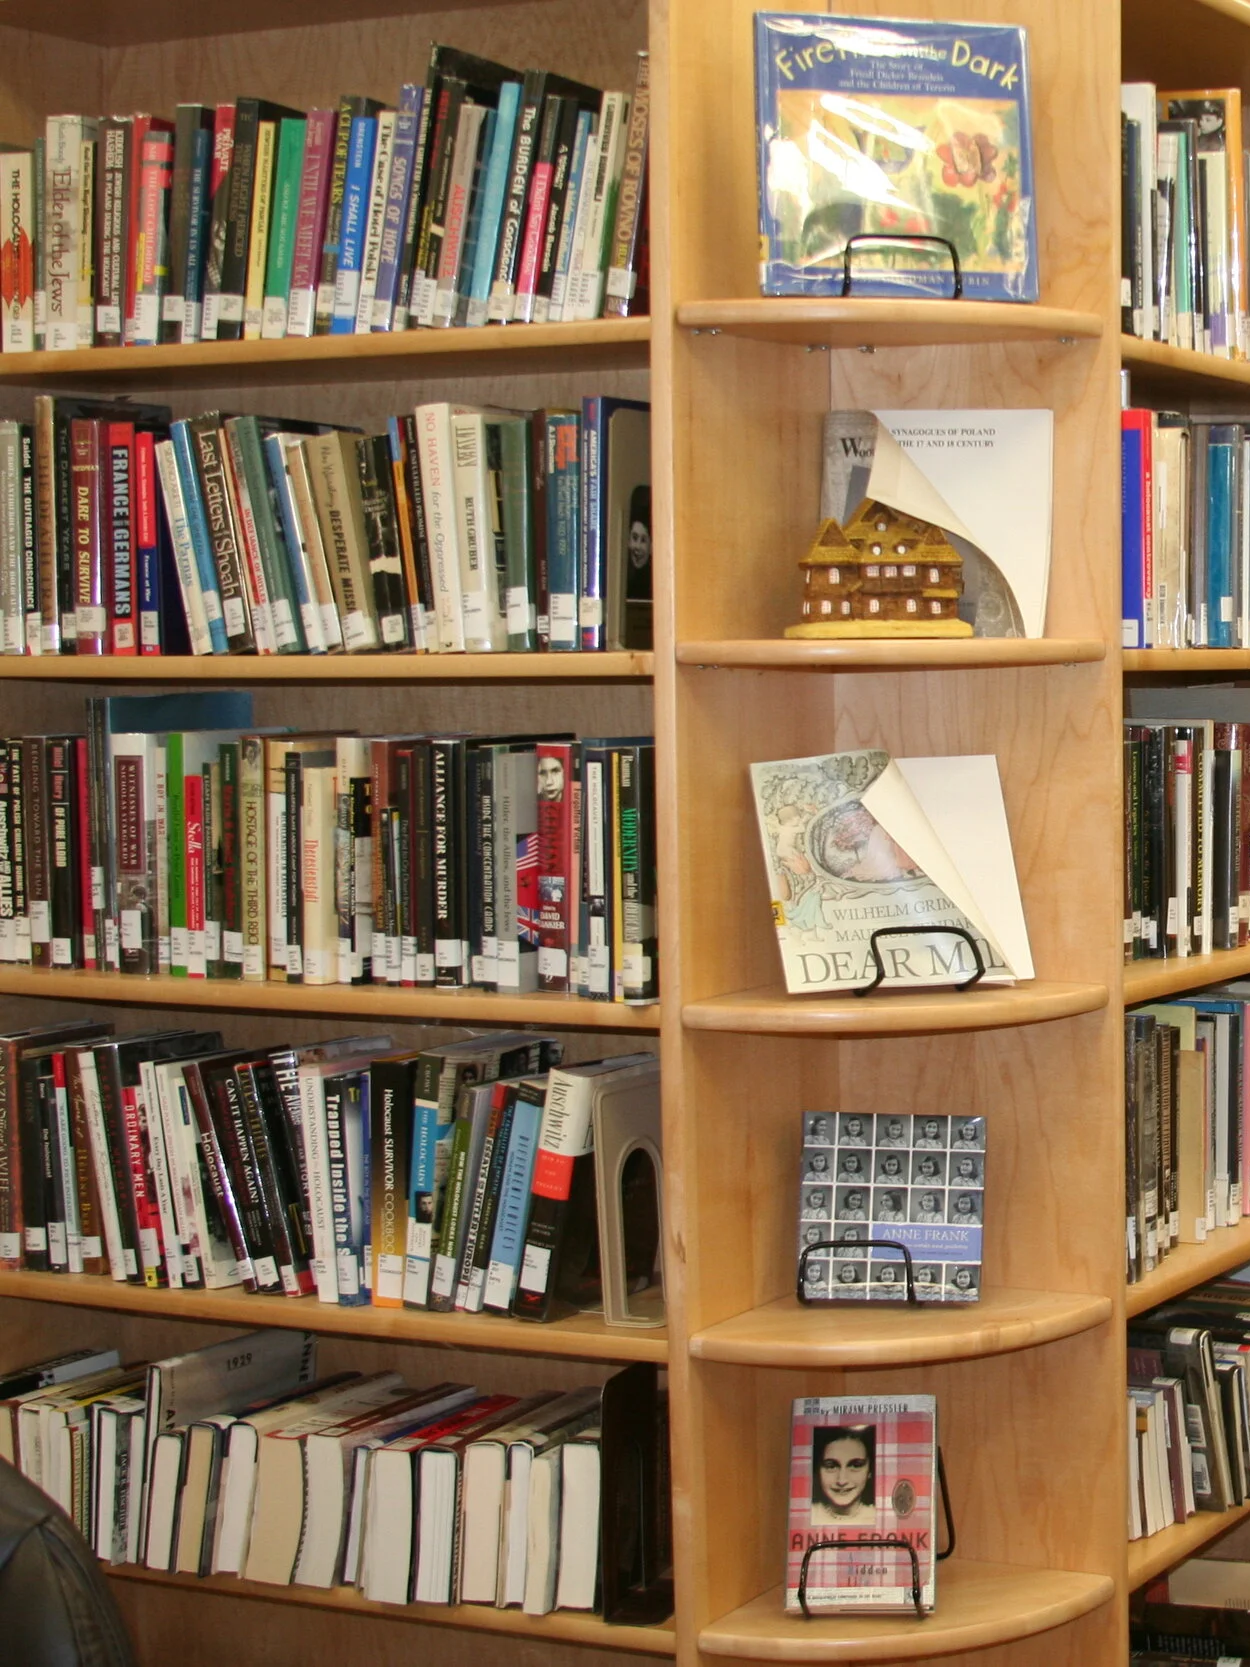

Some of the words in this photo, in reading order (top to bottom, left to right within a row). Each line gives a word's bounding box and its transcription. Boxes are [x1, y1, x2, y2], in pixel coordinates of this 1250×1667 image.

[638, 60, 650, 85] THE
[870, 61, 884, 69] The
[888, 62, 907, 71] Story
[951, 39, 1019, 91] Dark
[838, 80, 854, 88] and
[856, 80, 870, 88] the
[873, 80, 910, 90] Children
[339, 114, 350, 139] CUP
[521, 106, 537, 131] The
[628, 88, 649, 148] MOSES
[115, 130, 124, 168] KIDDUSH
[337, 141, 349, 159] OF
[354, 122, 365, 168] ORENSTEIN
[381, 122, 393, 149] The
[377, 151, 390, 183] Case
[390, 156, 408, 199] SONGS
[511, 134, 532, 194] BURDEN
[625, 151, 642, 177] OF
[52, 166, 72, 219] Elder
[105, 183, 113, 210] POLAND
[114, 173, 122, 198] JEWISH
[332, 162, 347, 203] TEARS
[375, 185, 388, 197] of
[113, 199, 121, 235] RELIGIOUS
[346, 194, 360, 233] SHALL
[370, 202, 384, 237] Hotel
[387, 205, 402, 223] OF
[508, 199, 519, 214] of
[616, 179, 639, 240] ROVNO
[53, 223, 69, 240] of
[104, 212, 112, 239] DURING
[442, 184, 466, 277] AUSCHWITZ
[52, 244, 69, 268] the
[112, 238, 120, 252] AND
[343, 239, 357, 267] LIVE
[364, 241, 380, 282] Polski
[381, 228, 397, 265] HOPE
[103, 257, 111, 297] HOLOCAUST
[112, 255, 120, 288] CULTURAL
[49, 271, 70, 316] Jews
[425, 412, 437, 431] NO
[891, 428, 946, 436] SYNAGOGUES
[949, 428, 959, 436] OF
[961, 428, 996, 436] POLAND
[23, 437, 31, 468] Saidel
[198, 430, 214, 467] Last
[899, 440, 913, 448] THE
[916, 440, 924, 448] 17
[926, 440, 945, 448] AND
[947, 440, 954, 448] 18
[956, 440, 994, 448] CENTURY
[427, 438, 441, 487] HAVEN
[112, 449, 129, 516] FRANCE
[77, 486, 90, 521] DARE
[204, 472, 226, 531] Letters
[431, 491, 442, 508] for
[465, 496, 476, 526] RUTH
[24, 497, 33, 548] OUTRAGED
[78, 528, 90, 544] TO
[433, 512, 443, 529] the
[434, 532, 449, 593] Oppressed
[467, 528, 479, 571] GRUBER
[25, 550, 34, 609] CONSCIENCE
[78, 551, 90, 603] SURVIVE
[114, 528, 131, 615] GERMANS
[214, 538, 238, 597] Shoah
[31, 744, 40, 793] BENDING
[120, 764, 128, 810] NICHOLAS
[129, 764, 137, 821] WITNESSES
[435, 750, 446, 823] ALLIANCE
[32, 797, 41, 844] TOWARD
[55, 807, 65, 817] OF
[482, 795, 492, 820] INSIDE
[55, 819, 65, 839] PURE
[129, 826, 137, 840] OF
[187, 821, 202, 854] Stella
[246, 802, 258, 848] HOSTAGE
[436, 826, 447, 855] FOR
[482, 823, 492, 838] THE
[55, 841, 67, 867] BLOOD
[130, 843, 138, 866] WAR
[246, 852, 258, 866] OF
[34, 873, 42, 896] SUN
[246, 869, 258, 885] THE
[304, 840, 322, 903] Theresienstadt
[482, 842, 493, 902] CONCENTRATION
[247, 889, 259, 919] THIRD
[436, 858, 448, 919] MURDER
[483, 906, 493, 932] CAMPS
[832, 903, 910, 921] WILHELM
[913, 899, 957, 915] GRIM
[797, 947, 921, 985] DEAR
[225, 1079, 238, 1103] CAN
[424, 1064, 433, 1094] CROWE
[230, 1105, 240, 1117] IT
[326, 1094, 343, 1158] Trapped
[384, 1088, 394, 1135] Holocaust
[543, 1079, 574, 1149] Auschwitz
[125, 1105, 141, 1165] ORDINARY
[233, 1120, 250, 1161] HAPPEN
[200, 1132, 225, 1198] Holocaust
[384, 1138, 395, 1191] SURVIVOR
[418, 1126, 429, 1188] HOLOCAUST
[132, 1173, 145, 1198] MEN
[243, 1165, 259, 1203] AGAIN?
[331, 1163, 347, 1212] Inside
[335, 1217, 351, 1242] the
[384, 1193, 395, 1255] COOKBOO
[882, 1228, 922, 1241] ANNE
[924, 1229, 969, 1241] FRANK
[226, 1351, 253, 1372] 1929
[820, 1408, 830, 1416] by
[833, 1405, 865, 1414] MIRJAM
[867, 1403, 909, 1414] PRESSLER
[791, 1531, 850, 1550] ANNE
[856, 1531, 928, 1550] FRANK
